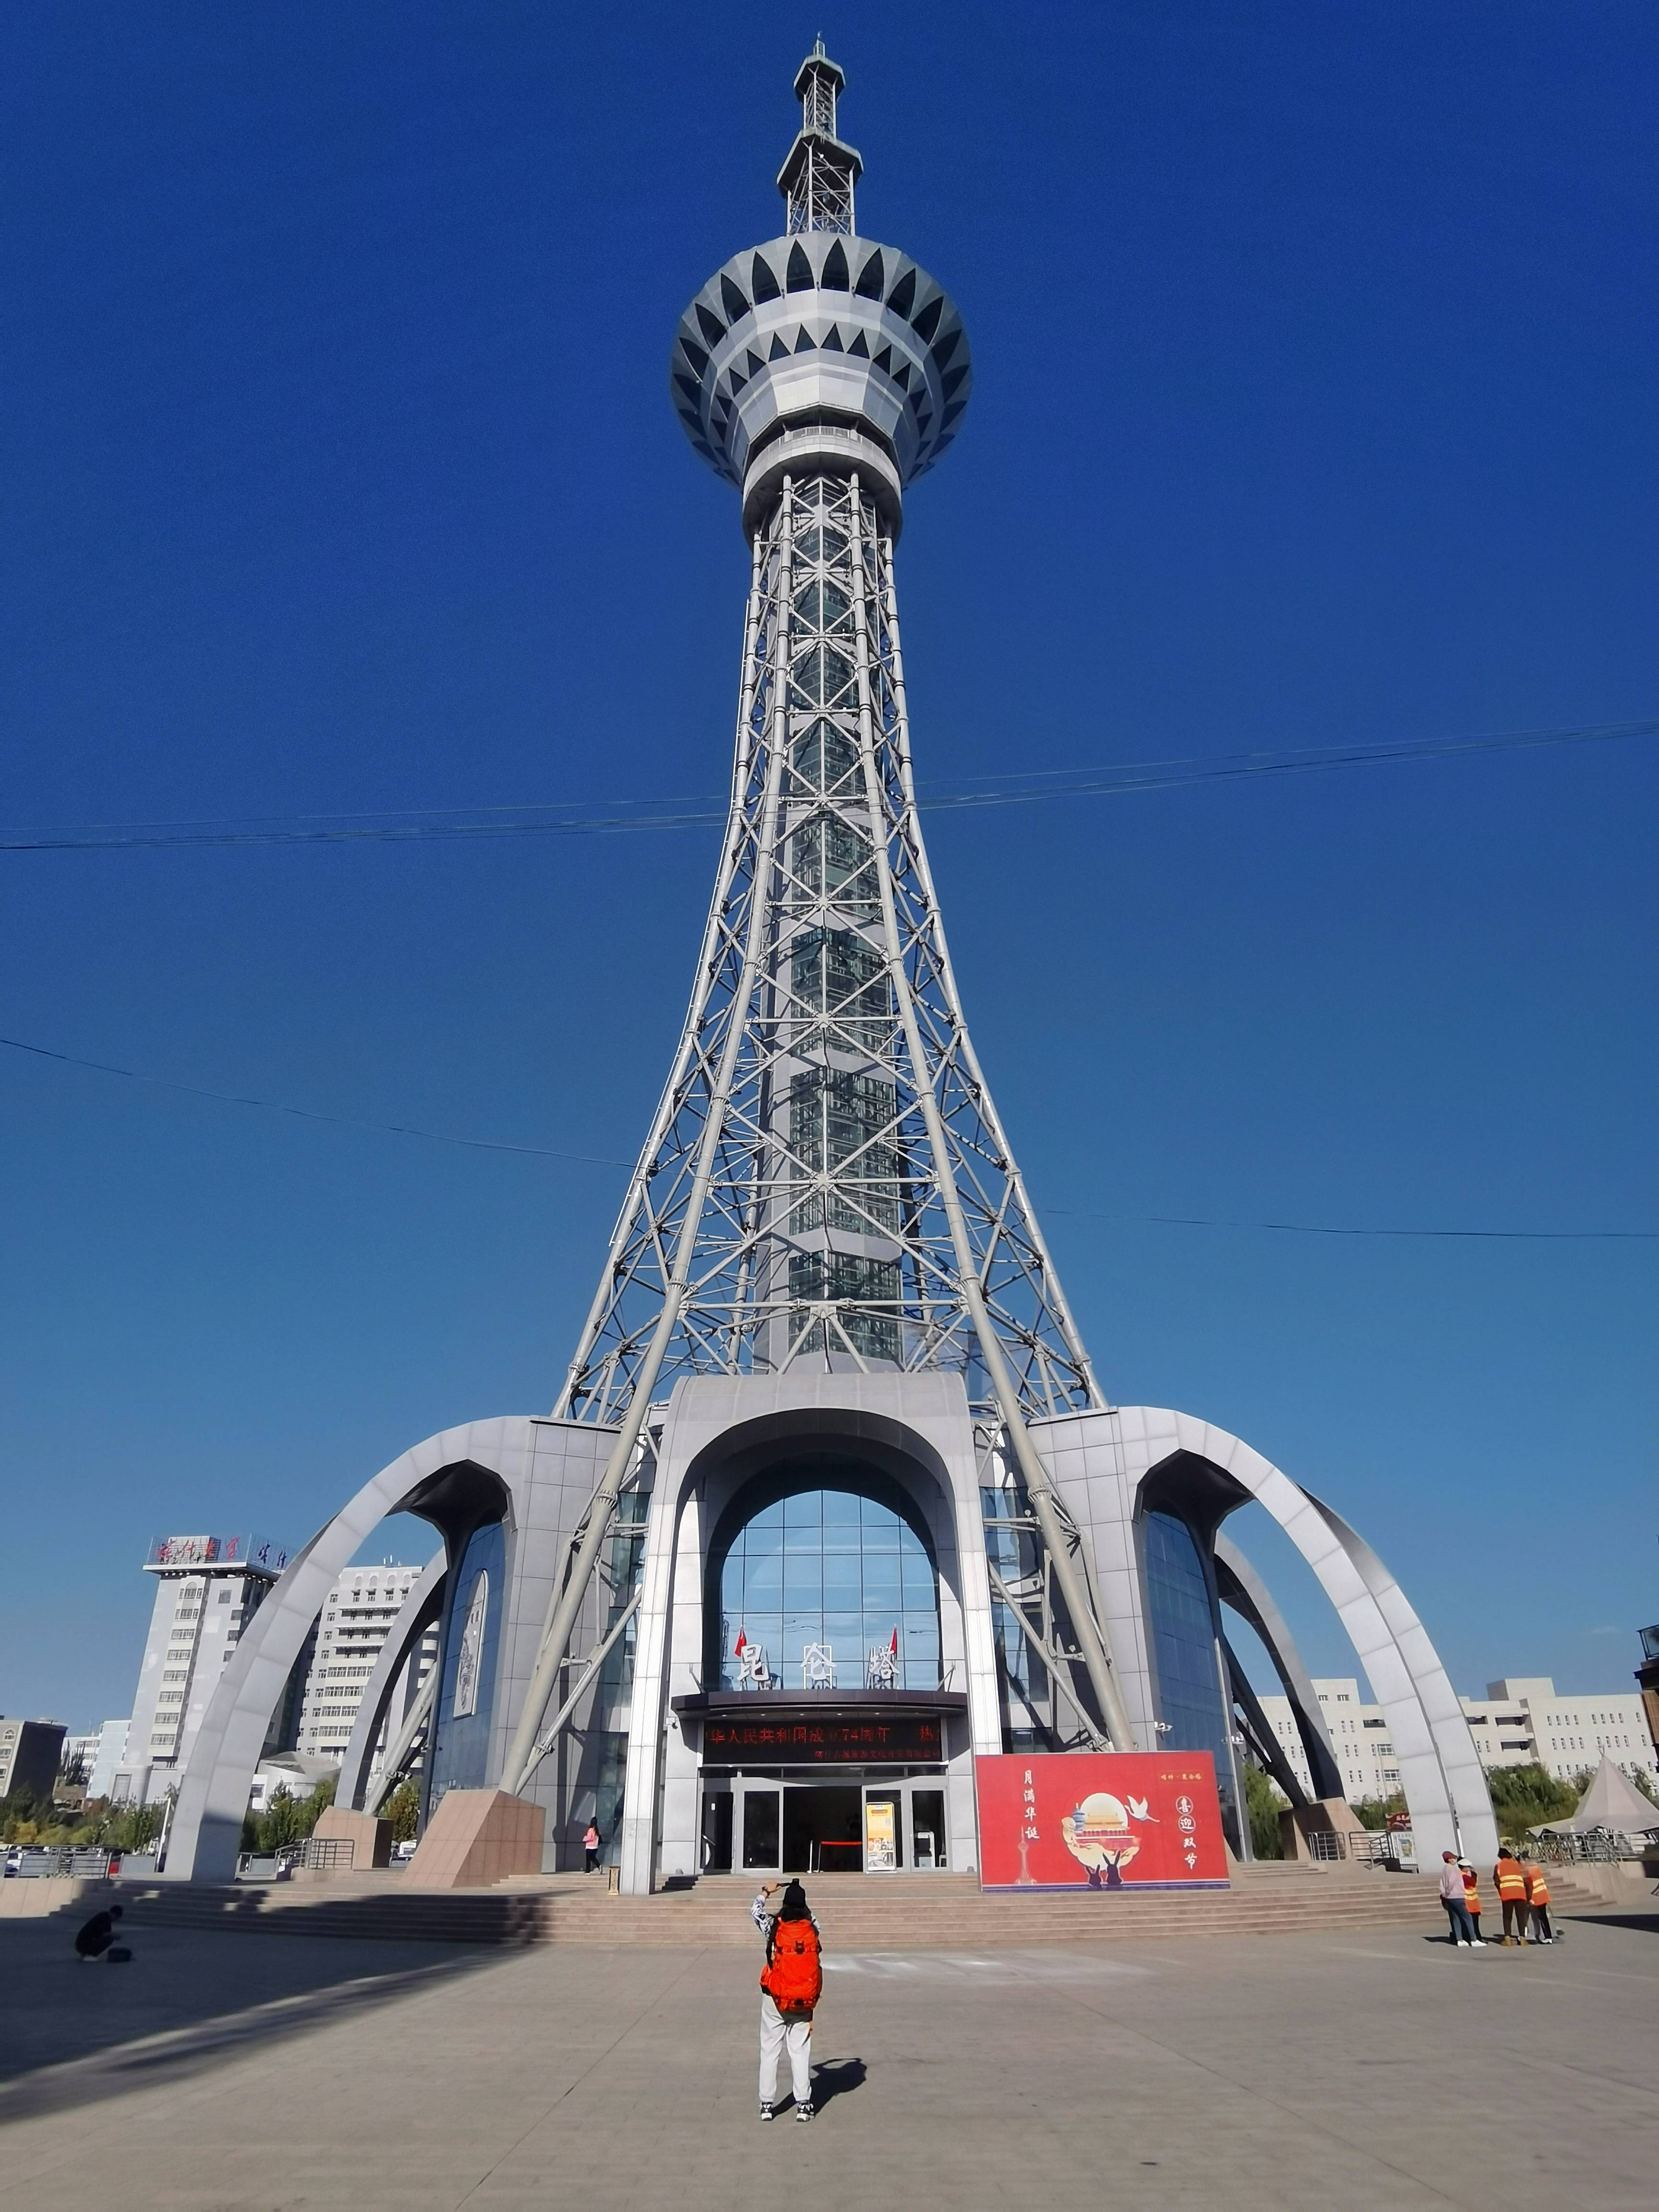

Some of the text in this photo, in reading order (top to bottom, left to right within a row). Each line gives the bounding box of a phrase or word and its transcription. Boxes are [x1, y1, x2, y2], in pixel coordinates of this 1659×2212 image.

[737, 1642, 901, 1681] 昆仑塔
[1023, 1769, 1040, 1839] 月满华诞
[1178, 1797, 1198, 1870] 喜迎双节
